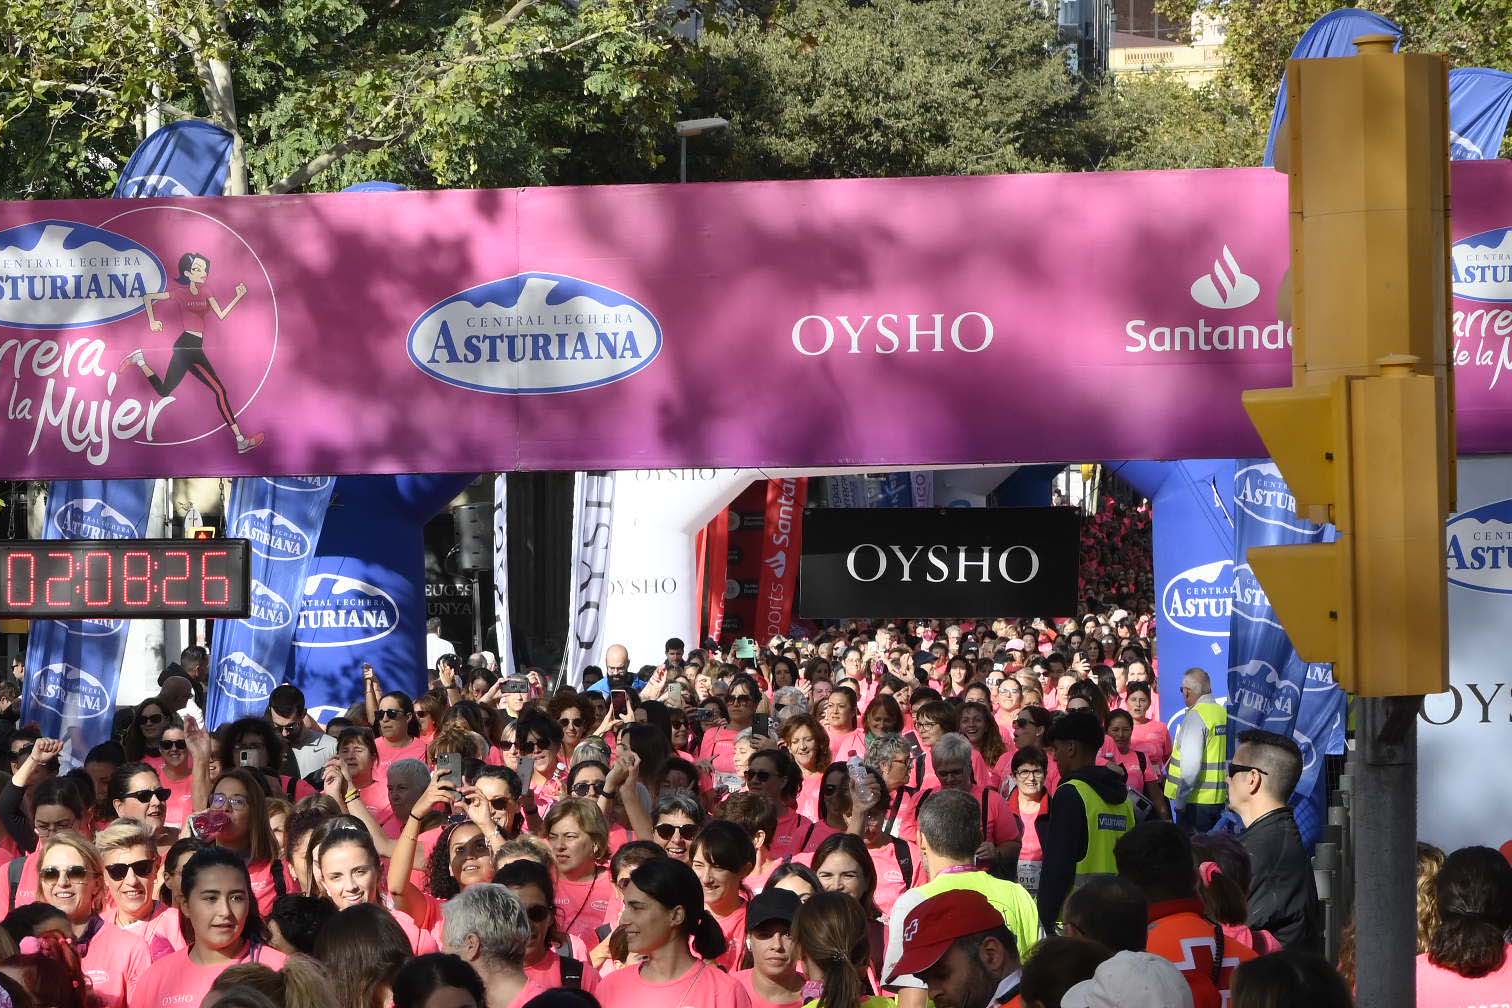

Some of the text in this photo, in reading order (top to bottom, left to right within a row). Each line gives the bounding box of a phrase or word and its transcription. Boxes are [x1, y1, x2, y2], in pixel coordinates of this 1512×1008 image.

[70, 256, 141, 267] LECHERA
[1466, 252, 1512, 262] CENTRA
[466, 313, 634, 327] CENTRAL LECHERA
[792, 312, 994, 355] OYSHO
[1125, 319, 1294, 352] Santand
[427, 320, 642, 364] ASTURIANA
[8, 380, 32, 420] la
[28, 372, 176, 466] Mujer
[1238, 476, 1297, 512] ASTUR
[239, 519, 300, 555] ASTURIANA
[1473, 531, 1512, 541] CENT
[7, 552, 229, 606] 02:08:26
[846, 543, 1039, 584] OYSHO
[298, 610, 390, 628] TURIANA
